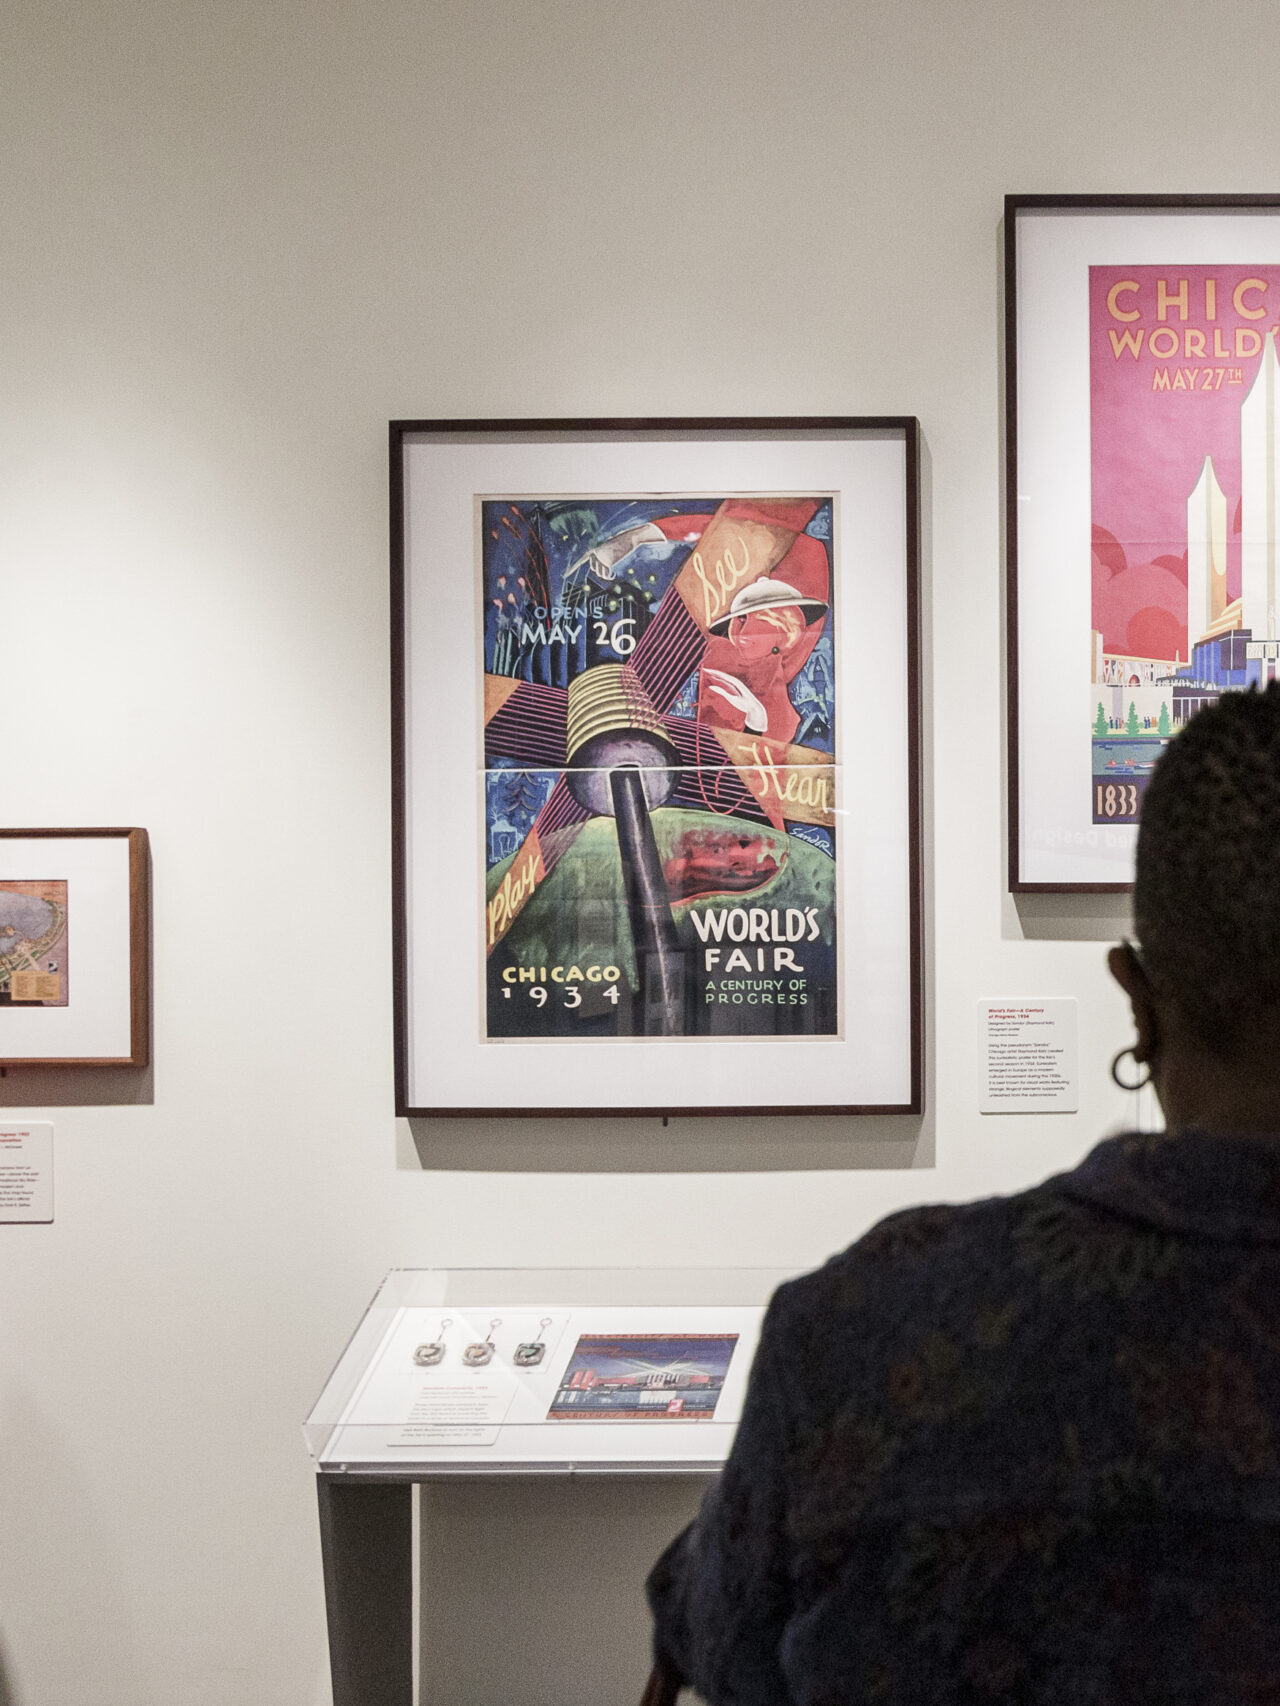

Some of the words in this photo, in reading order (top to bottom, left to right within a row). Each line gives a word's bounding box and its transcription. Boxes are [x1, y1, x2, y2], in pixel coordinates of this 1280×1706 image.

[1152, 367, 1202, 391] MAY
[693, 537, 749, 627] See
[533, 606, 604, 619] OPENS
[521, 623, 583, 645] MAY
[593, 618, 637, 655] 26
[738, 742, 829, 814] Hear
[1097, 785, 1137, 817] 1833
[689, 906, 820, 943] WORLD'S
[705, 947, 805, 973] FAIR
[502, 965, 621, 983] CHICAGO
[705, 980, 717, 991] A
[720, 980, 784, 991] CENTURY
[788, 979, 807, 991] OF
[501, 984, 621, 1008] 1934
[705, 992, 808, 1005] PROGRESS
